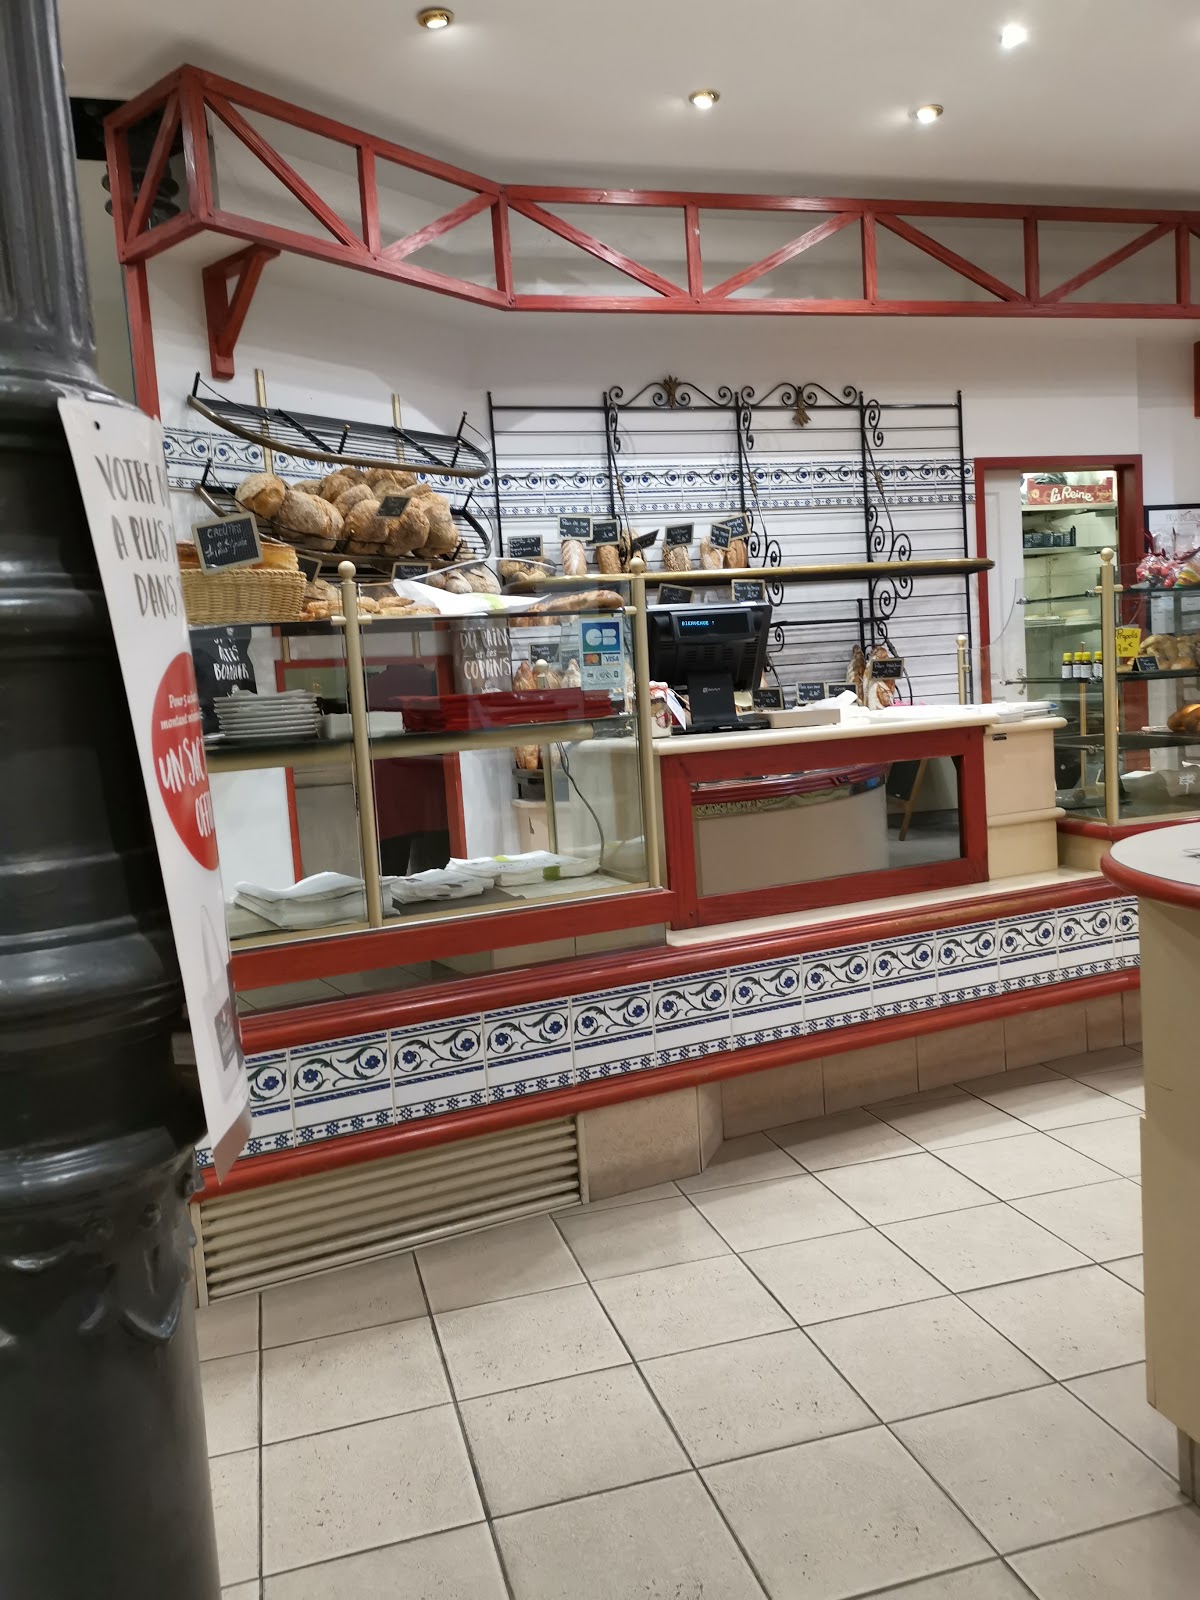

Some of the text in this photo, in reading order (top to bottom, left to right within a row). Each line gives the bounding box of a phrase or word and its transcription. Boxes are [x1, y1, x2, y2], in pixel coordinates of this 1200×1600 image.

[94, 454, 156, 504] VOTRE
[1061, 486, 1094, 501] Reine
[111, 515, 129, 560] A
[128, 515, 168, 562] PLUS
[134, 573, 178, 619] DANS
[459, 627, 513, 650] DU PAIN
[1116, 628, 1138, 642] Propolis
[464, 657, 512, 680] COPAINS
[158, 745, 186, 794] UN
